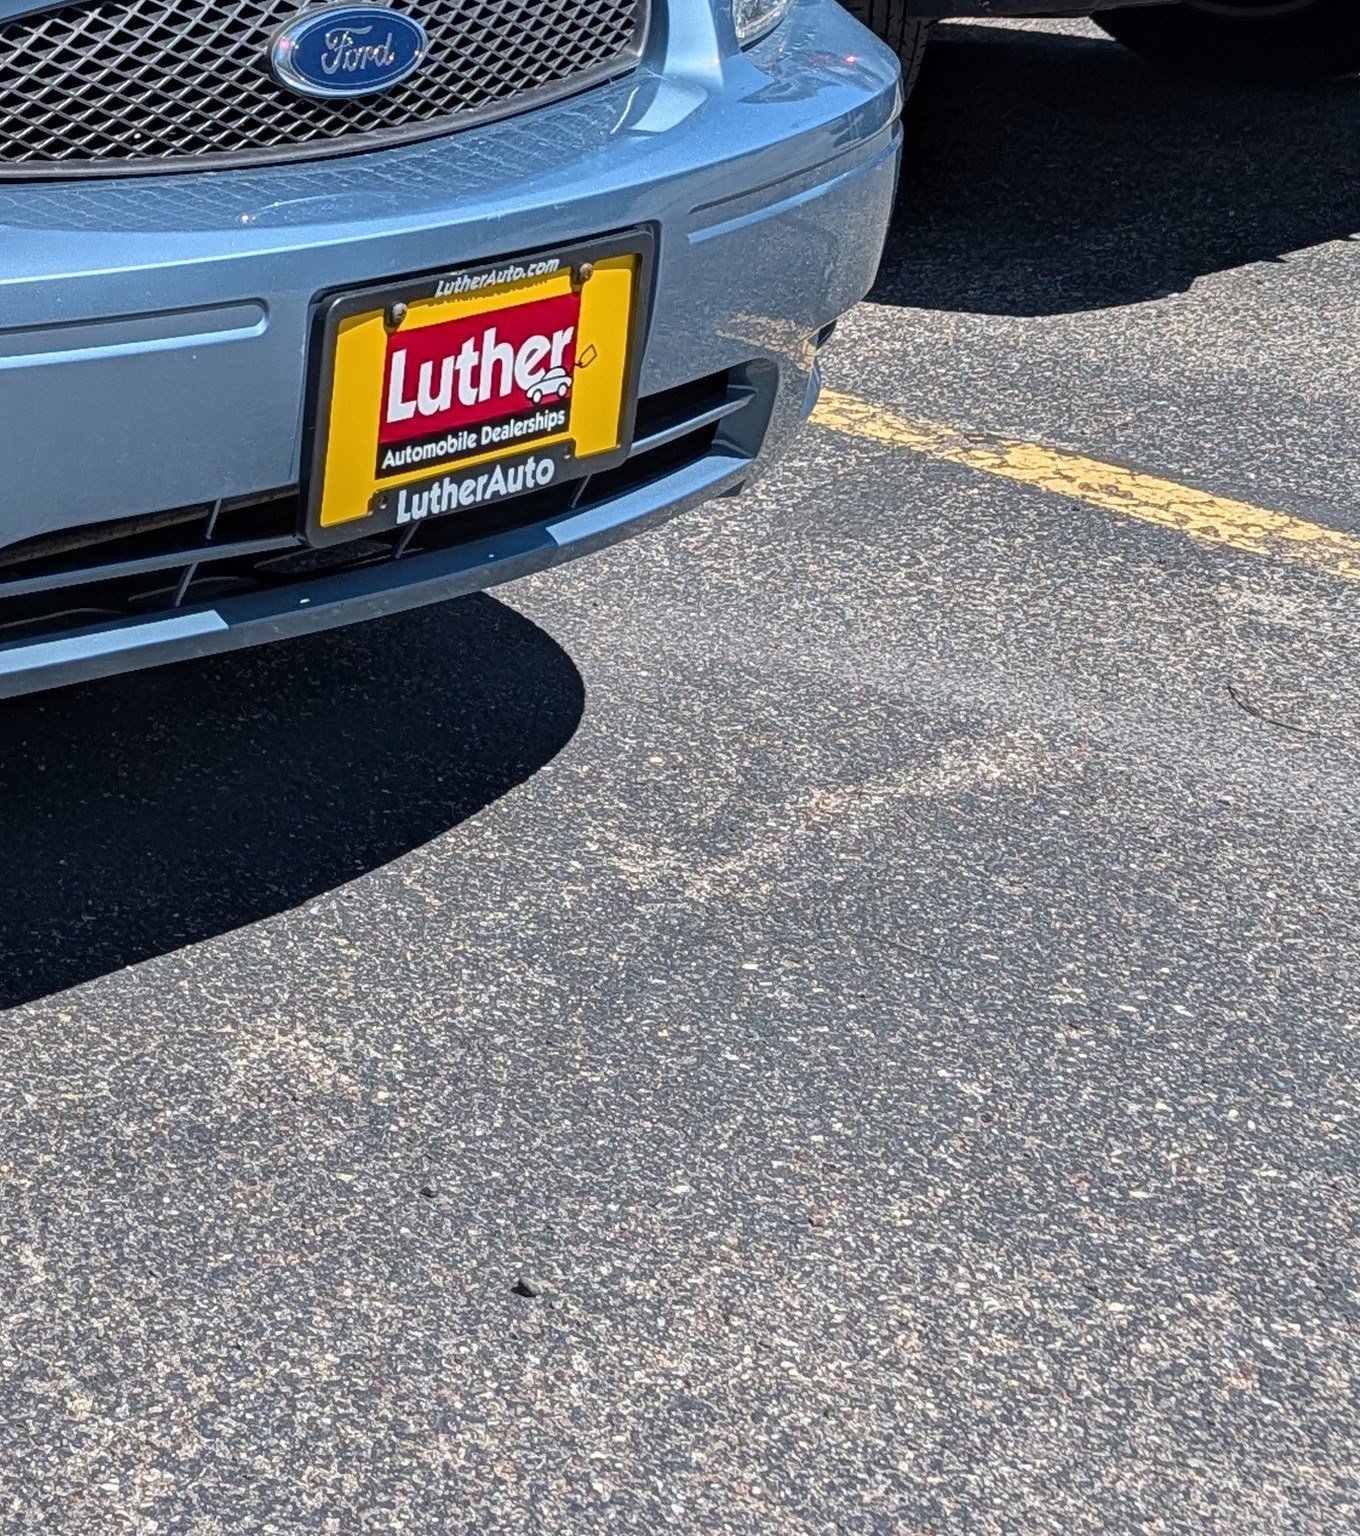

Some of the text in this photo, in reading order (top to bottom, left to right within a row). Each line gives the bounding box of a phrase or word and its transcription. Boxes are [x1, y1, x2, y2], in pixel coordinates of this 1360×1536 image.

[320, 24, 395, 75] Ford
[434, 258, 560, 298] LutherAuto.com
[385, 325, 575, 423] Luther
[381, 408, 566, 470] Automobile Dealerships
[396, 455, 556, 525] LutherAuto
